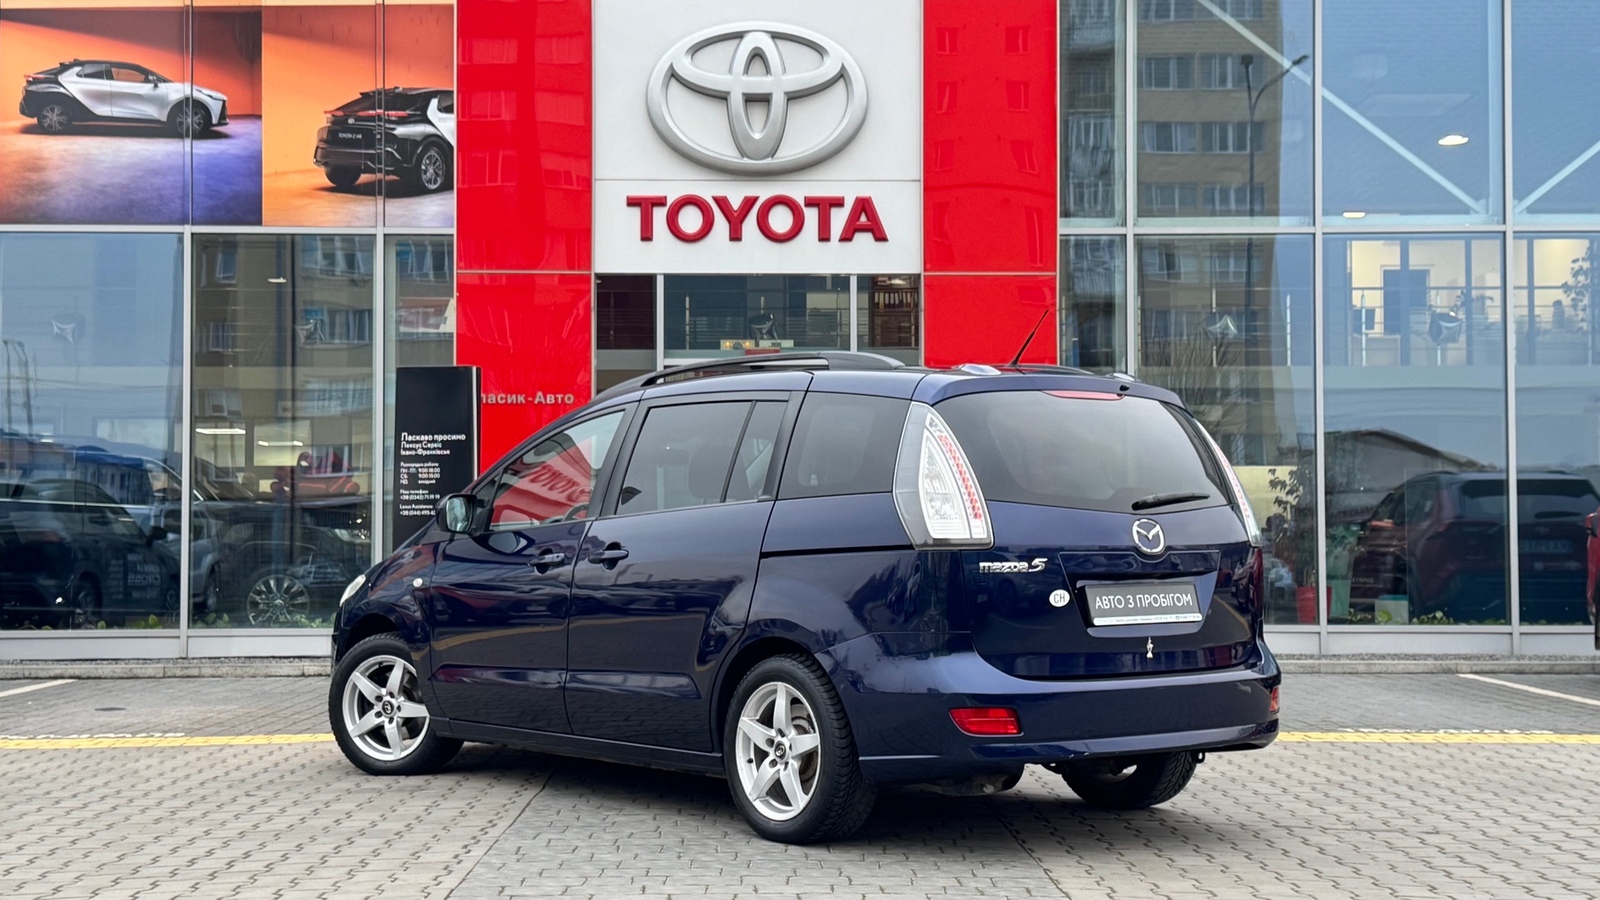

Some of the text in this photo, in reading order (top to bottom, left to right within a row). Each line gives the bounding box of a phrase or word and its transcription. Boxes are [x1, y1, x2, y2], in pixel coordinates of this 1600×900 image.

[626, 194, 889, 243] TOYOTA
[434, 434, 466, 442] просимо
[1053, 593, 1066, 604] CH
[1095, 593, 1193, 610] АВТО З ПРОБІГОМ
